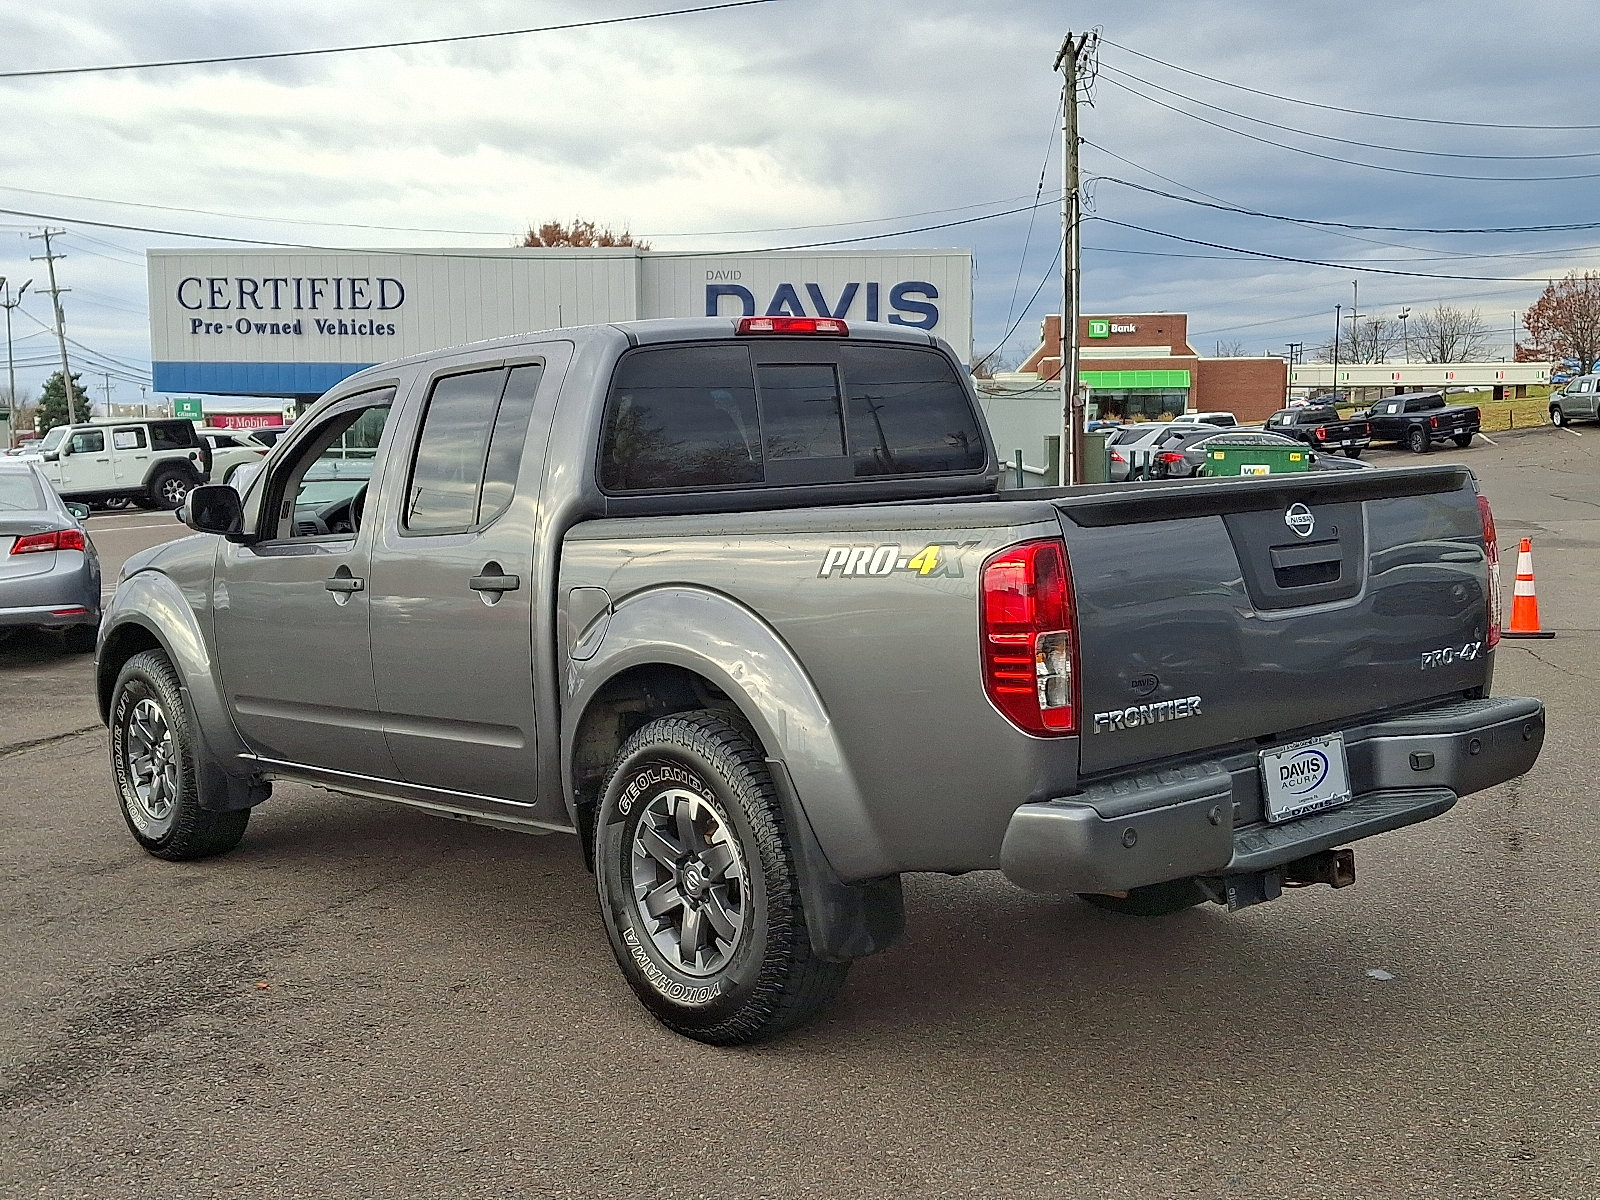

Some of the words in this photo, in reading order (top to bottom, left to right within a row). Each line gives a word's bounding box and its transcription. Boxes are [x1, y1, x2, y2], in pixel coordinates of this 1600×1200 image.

[706, 270, 742, 281] DAVID
[176, 276, 406, 310] CERTIFIED
[705, 281, 939, 331] DAVIS
[190, 317, 303, 335] Pre-Owned
[313, 317, 396, 336] Vehicles
[1090, 322, 1107, 334] TD
[1110, 323, 1136, 333] Bank
[1290, 515, 1313, 524] NISSAN
[816, 540, 981, 578] PRO-4X
[1420, 641, 1483, 670] PRO-4X
[1131, 677, 1155, 688] DAVIS
[1092, 695, 1203, 735] FRONTIER
[1279, 757, 1321, 781] DAVIS
[1281, 773, 1318, 789] ACURA
[623, 927, 722, 1003] YOKOHAMA
